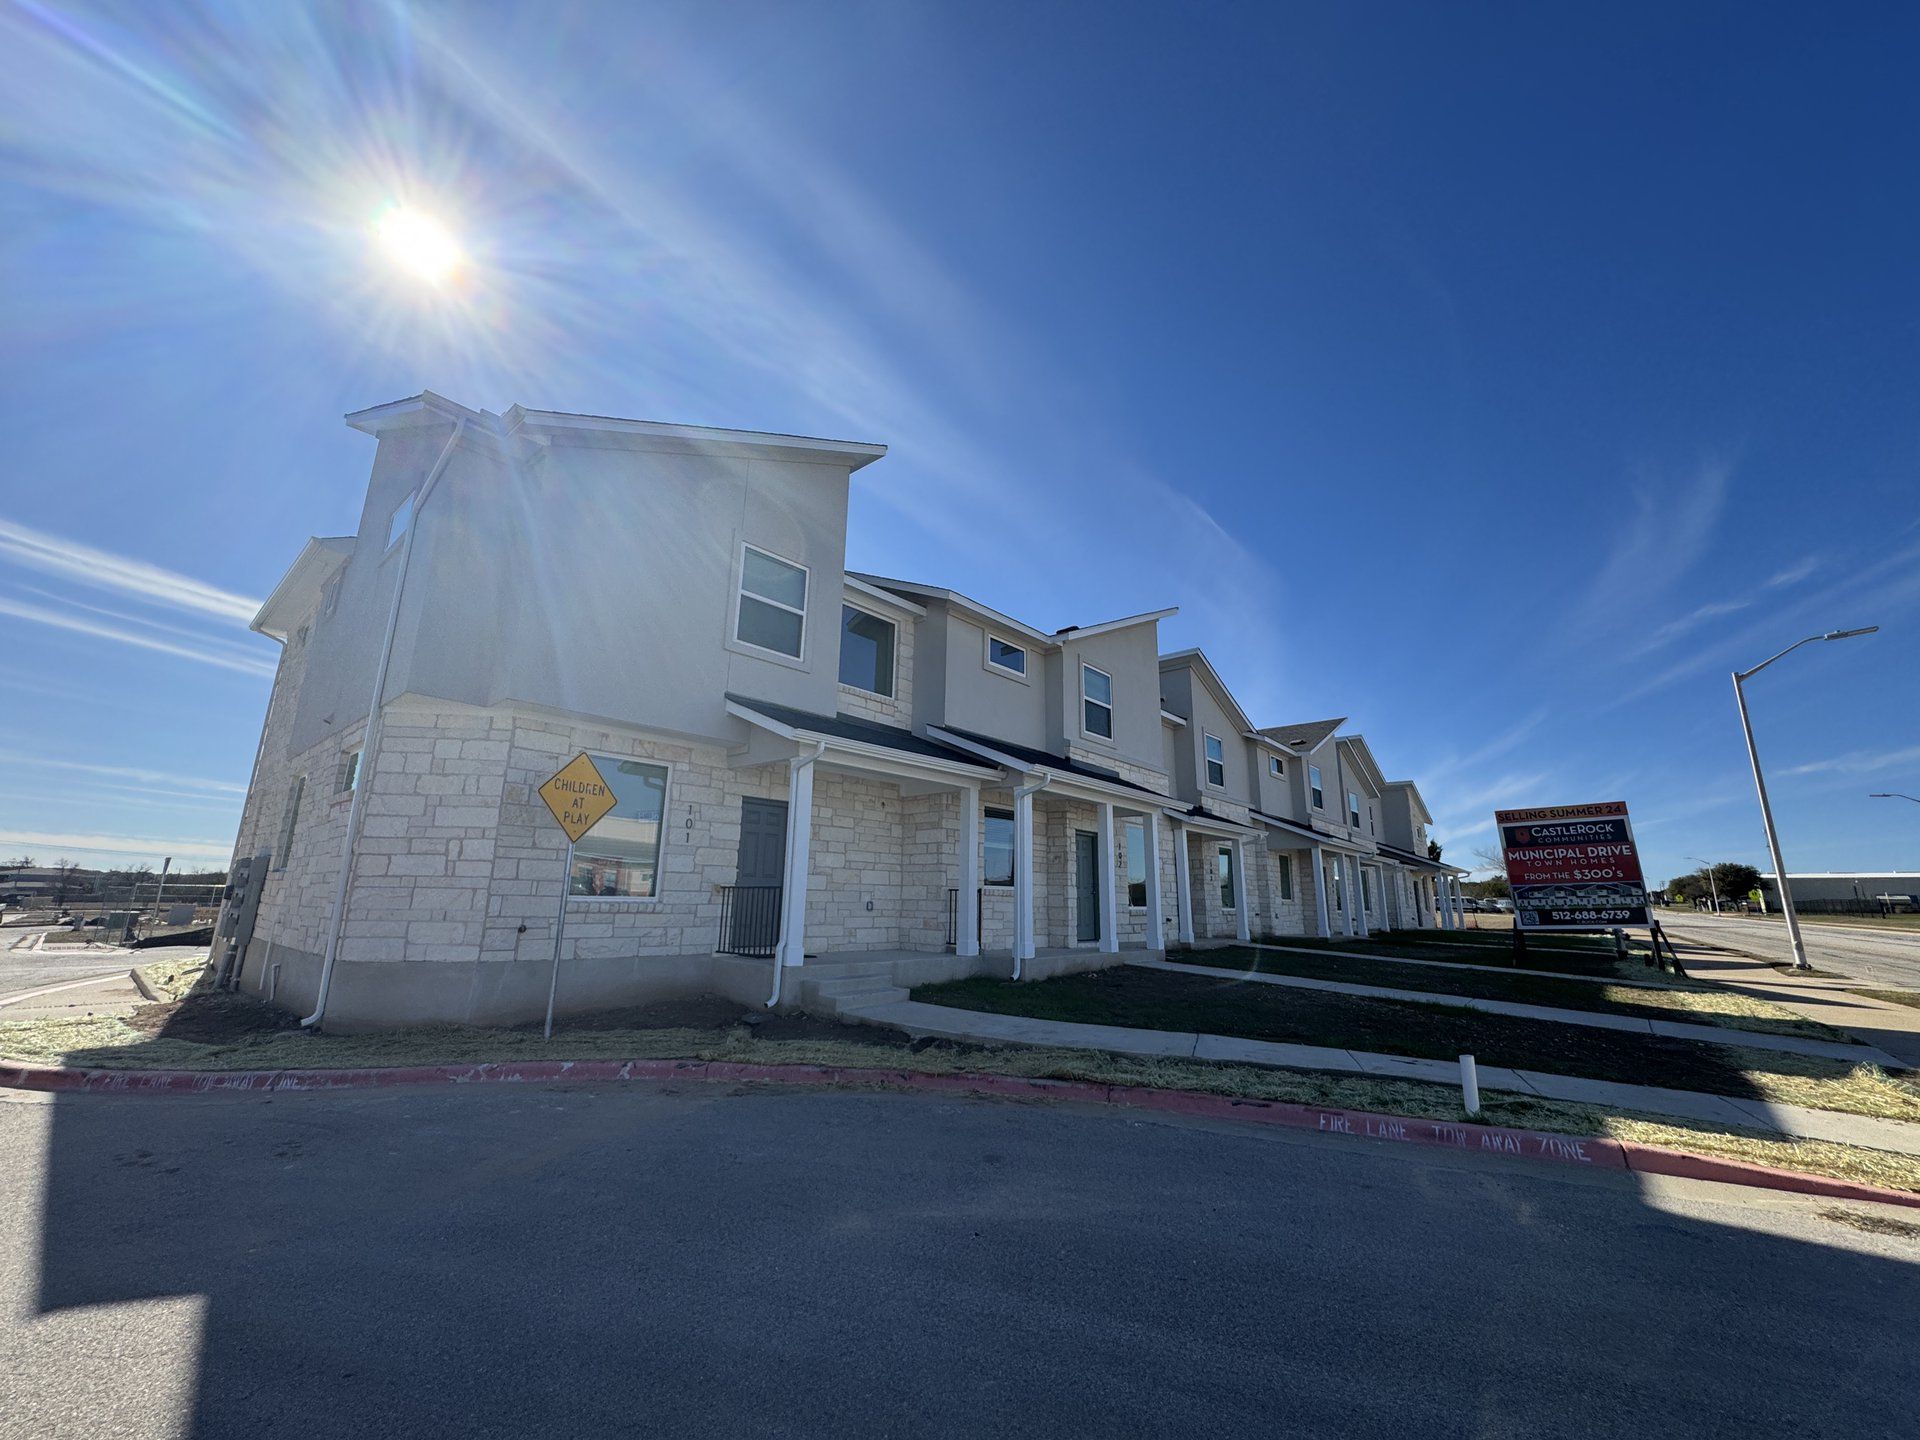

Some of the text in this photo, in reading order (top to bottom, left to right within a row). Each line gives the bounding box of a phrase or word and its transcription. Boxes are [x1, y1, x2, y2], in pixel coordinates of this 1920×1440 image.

[554, 777, 605, 797] CHILDREN
[572, 797, 585, 809] AT
[564, 811, 589, 826] PLAY
[1497, 810, 1547, 821] SELLING
[1549, 806, 1602, 818] SUMMER
[685, 804, 693, 843] 101
[1538, 833, 1612, 844] COMMUNITIES
[1508, 845, 1632, 861] MUNICIPAL DRIVE
[1570, 856, 1616, 865] HOMES
[1524, 872, 1551, 881] FROM
[1552, 871, 1571, 879] THE
[1552, 910, 1630, 920] 512-688-6739
[1319, 1112, 1591, 1162] FIRE LANE TOW AWAY ZONE
